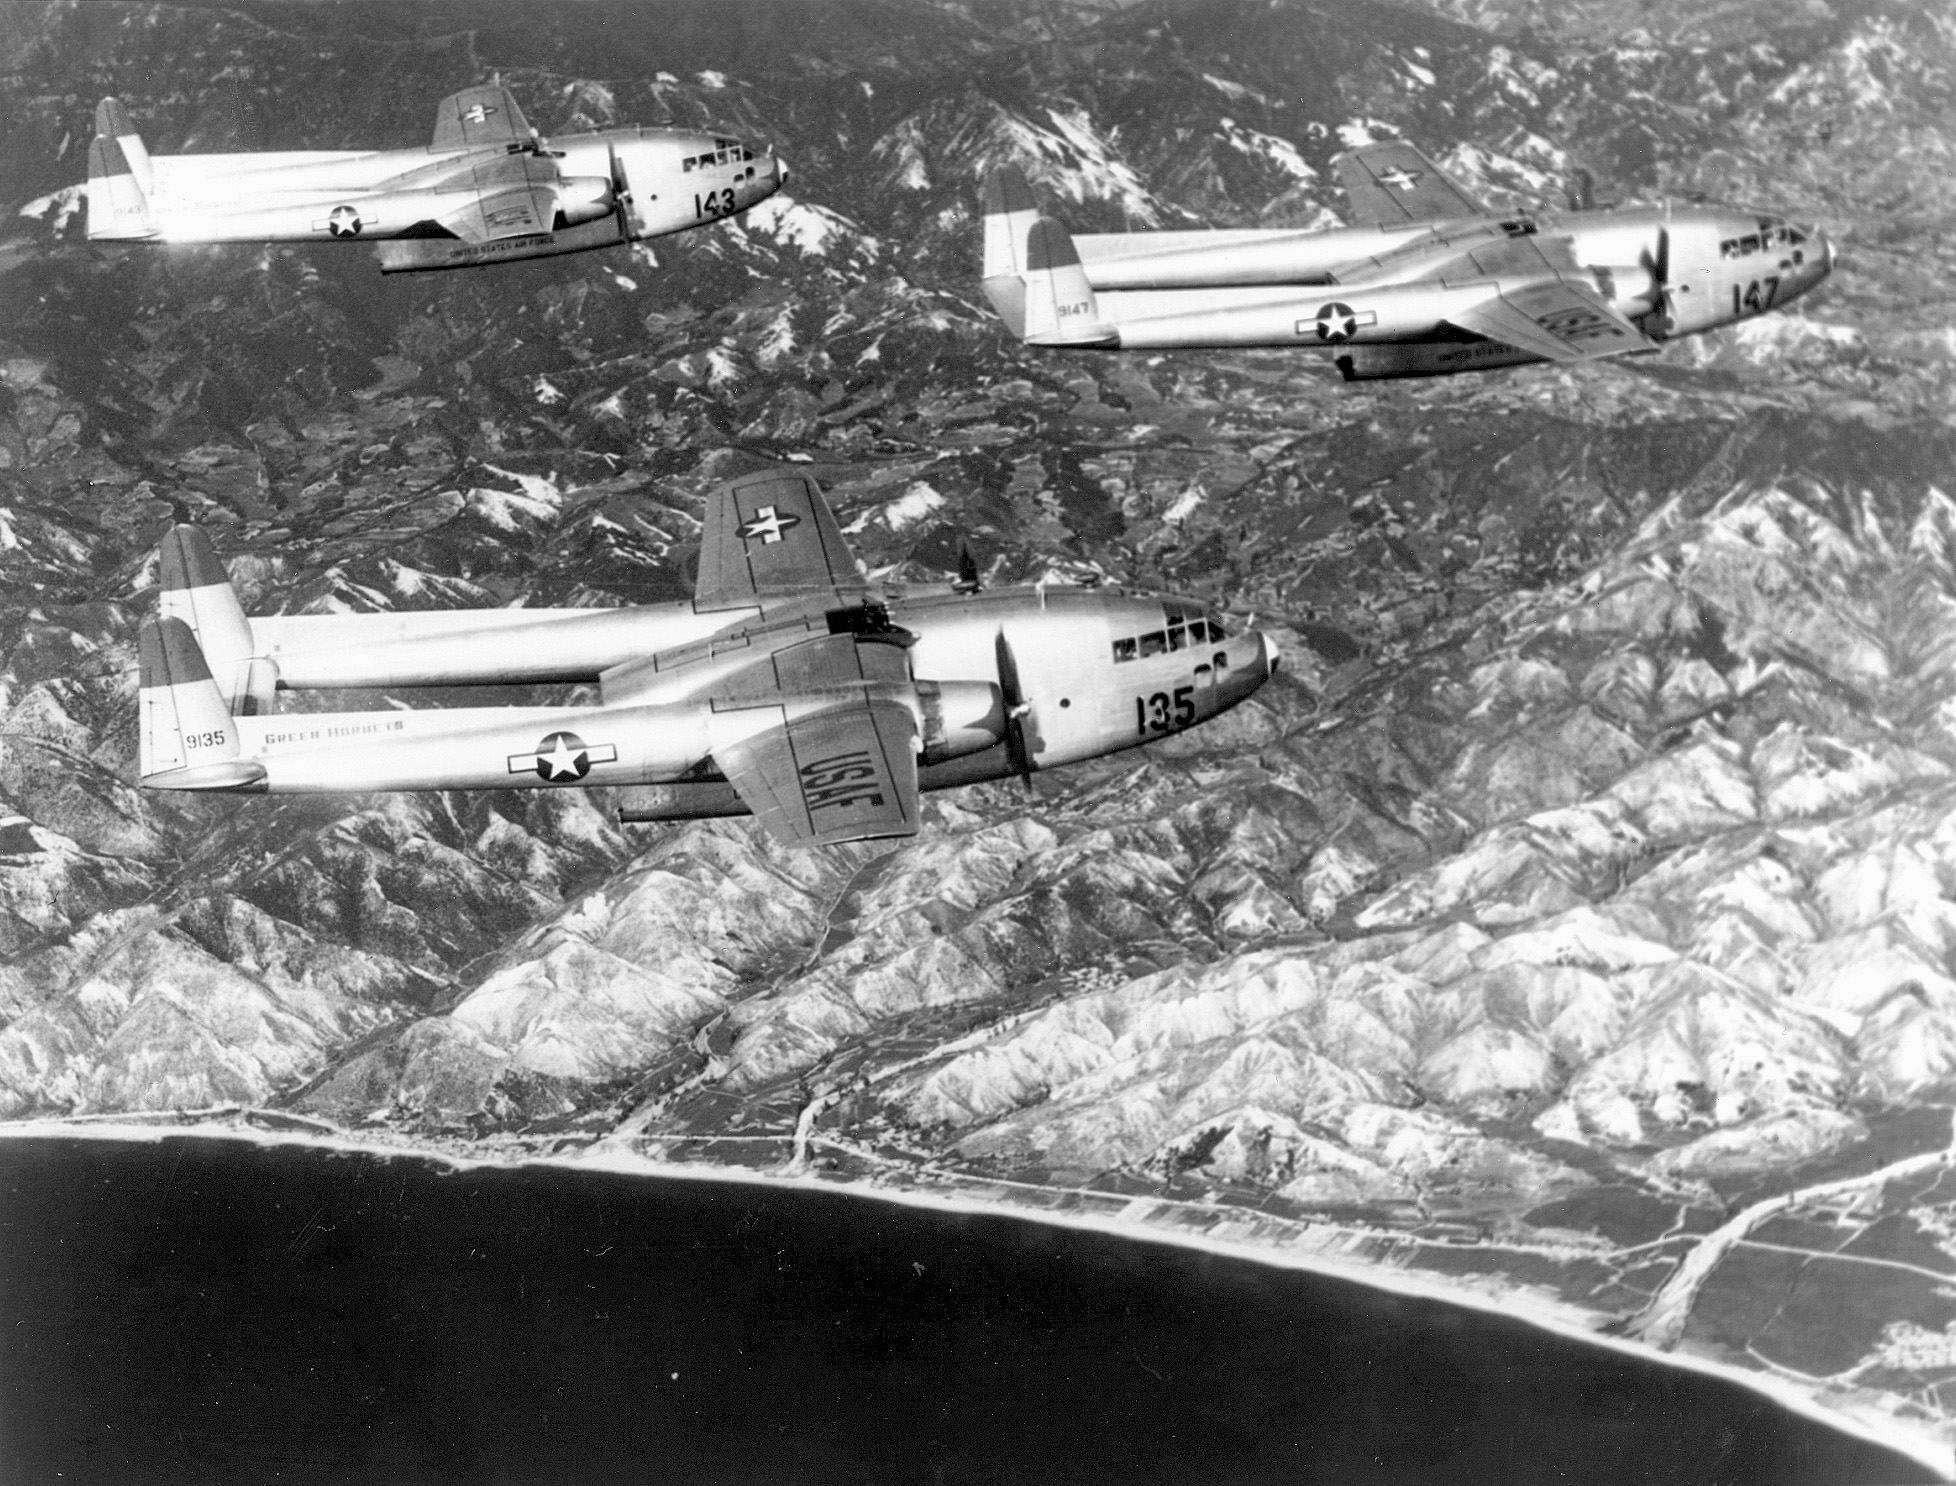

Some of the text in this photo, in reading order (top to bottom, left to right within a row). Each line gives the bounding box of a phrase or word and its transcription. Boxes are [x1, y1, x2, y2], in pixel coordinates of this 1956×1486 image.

[695, 188, 735, 219] 143
[480, 242, 511, 253] STATES
[1733, 277, 1781, 315] 147
[1059, 302, 1089, 317] 9147
[1136, 686, 1196, 735] 135
[186, 730, 226, 750] 9135
[265, 730, 320, 744] GREEN
[800, 750, 885, 812] USAF
